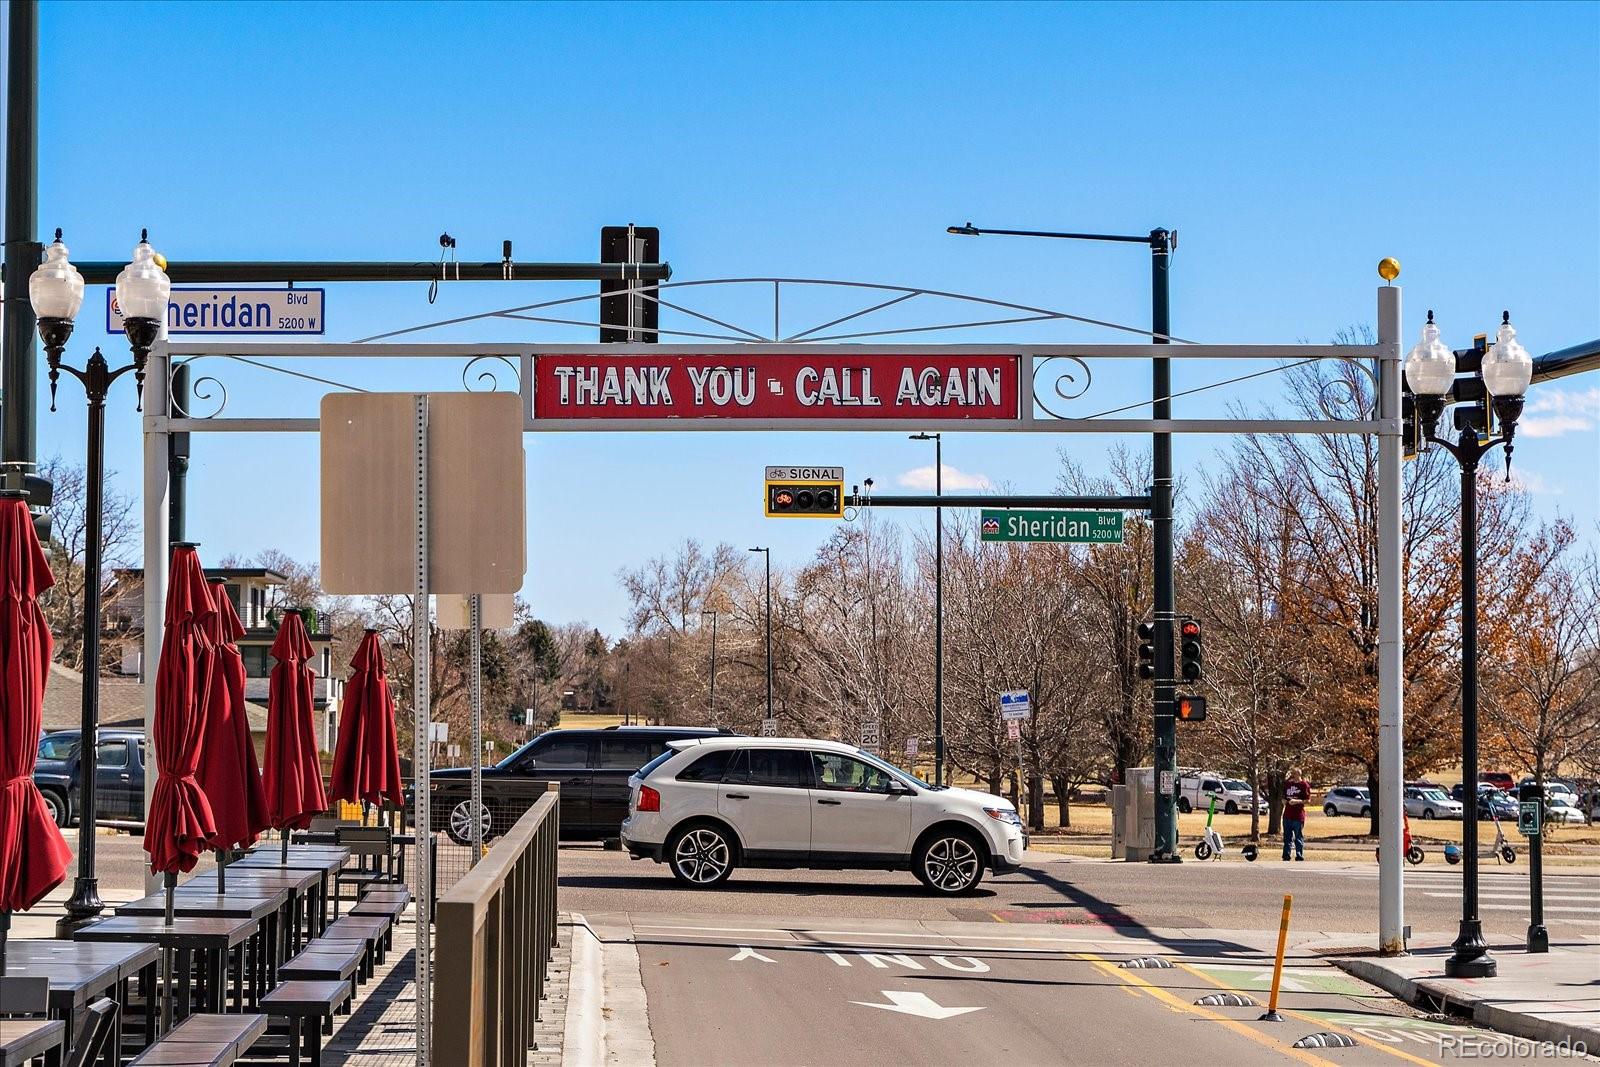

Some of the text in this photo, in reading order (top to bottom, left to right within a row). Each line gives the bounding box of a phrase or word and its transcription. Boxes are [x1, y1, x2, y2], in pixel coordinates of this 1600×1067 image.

[167, 293, 308, 327] heridan Blvd
[278, 317, 316, 329] 5200 W
[553, 366, 1001, 406] THANK YOU CALL AGAIN
[789, 469, 840, 480] SIGNAL
[1008, 516, 1090, 538] Sheridan
[1098, 516, 1116, 526] Blvd
[1092, 530, 1122, 539] 5200 W
[764, 729, 776, 737] 20
[862, 734, 878, 744] 20
[728, 943, 991, 973] ONLY
